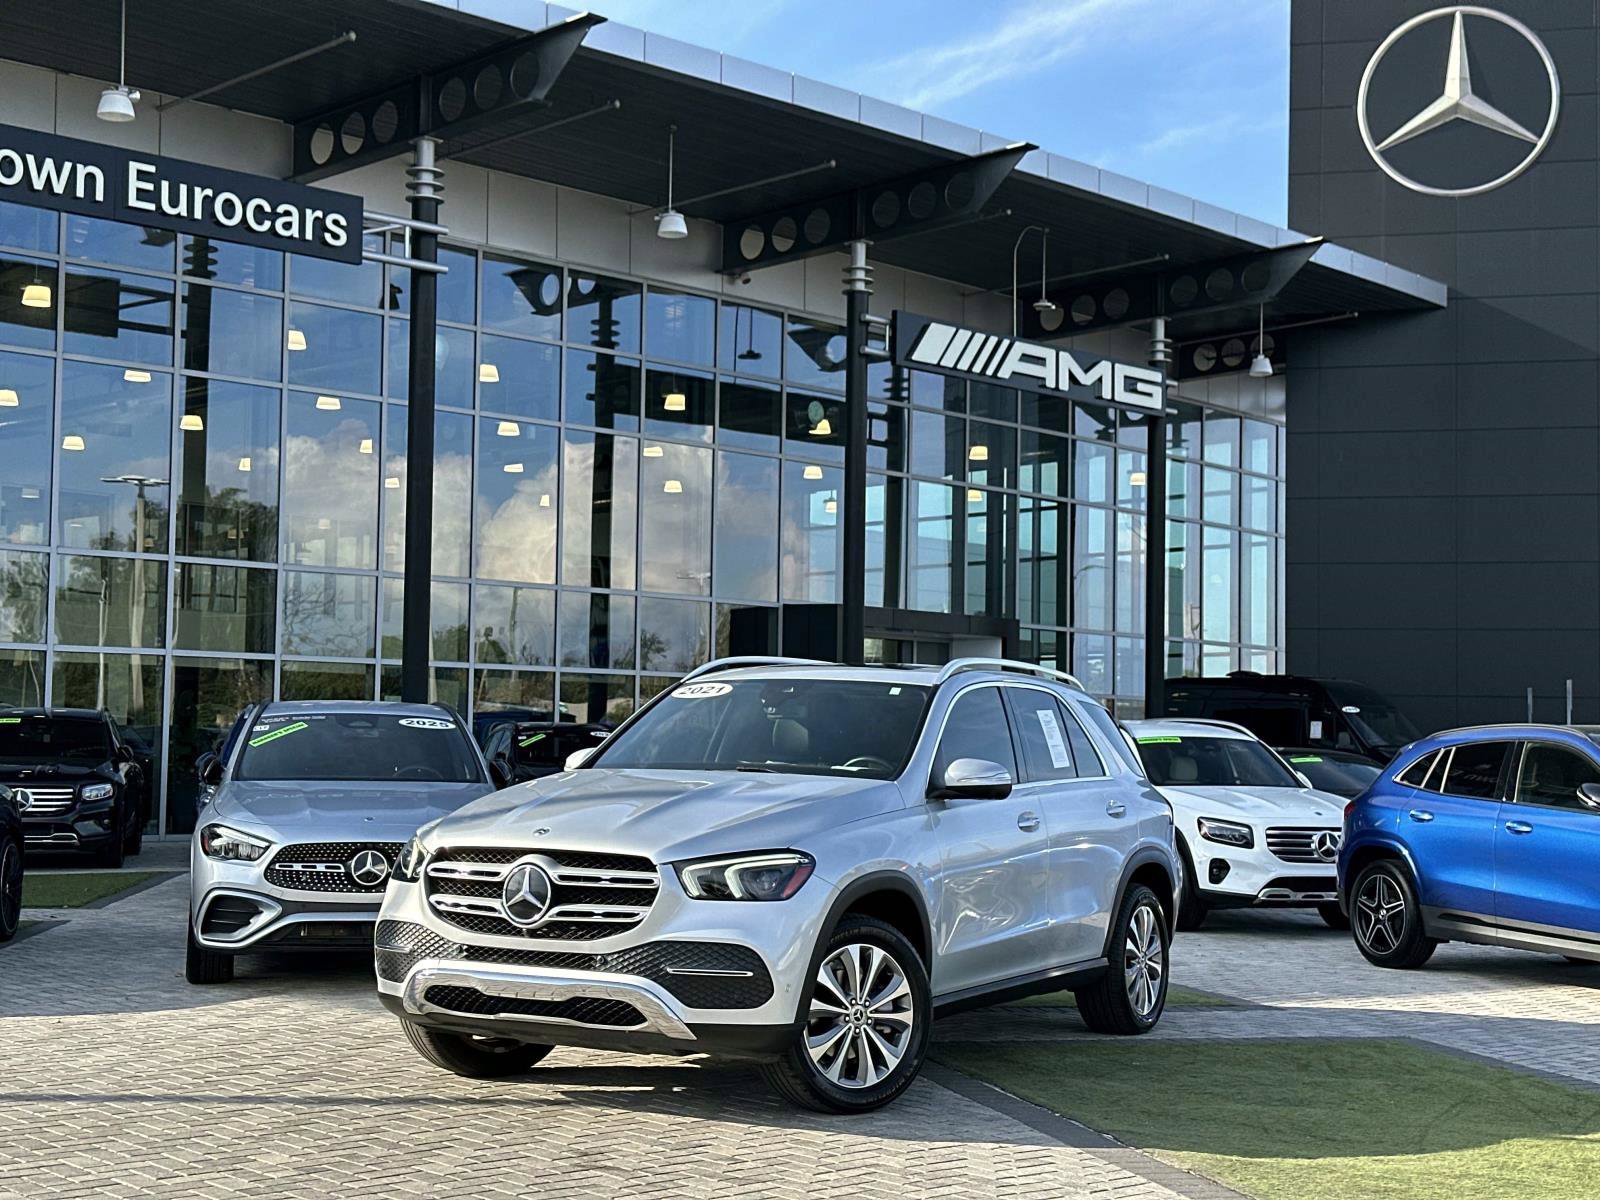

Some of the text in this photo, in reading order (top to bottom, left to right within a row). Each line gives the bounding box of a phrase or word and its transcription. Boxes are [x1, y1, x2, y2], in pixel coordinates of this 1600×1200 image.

[0, 148, 348, 247] own Eurocars
[997, 340, 1163, 410] AMG
[678, 685, 726, 695] 2021
